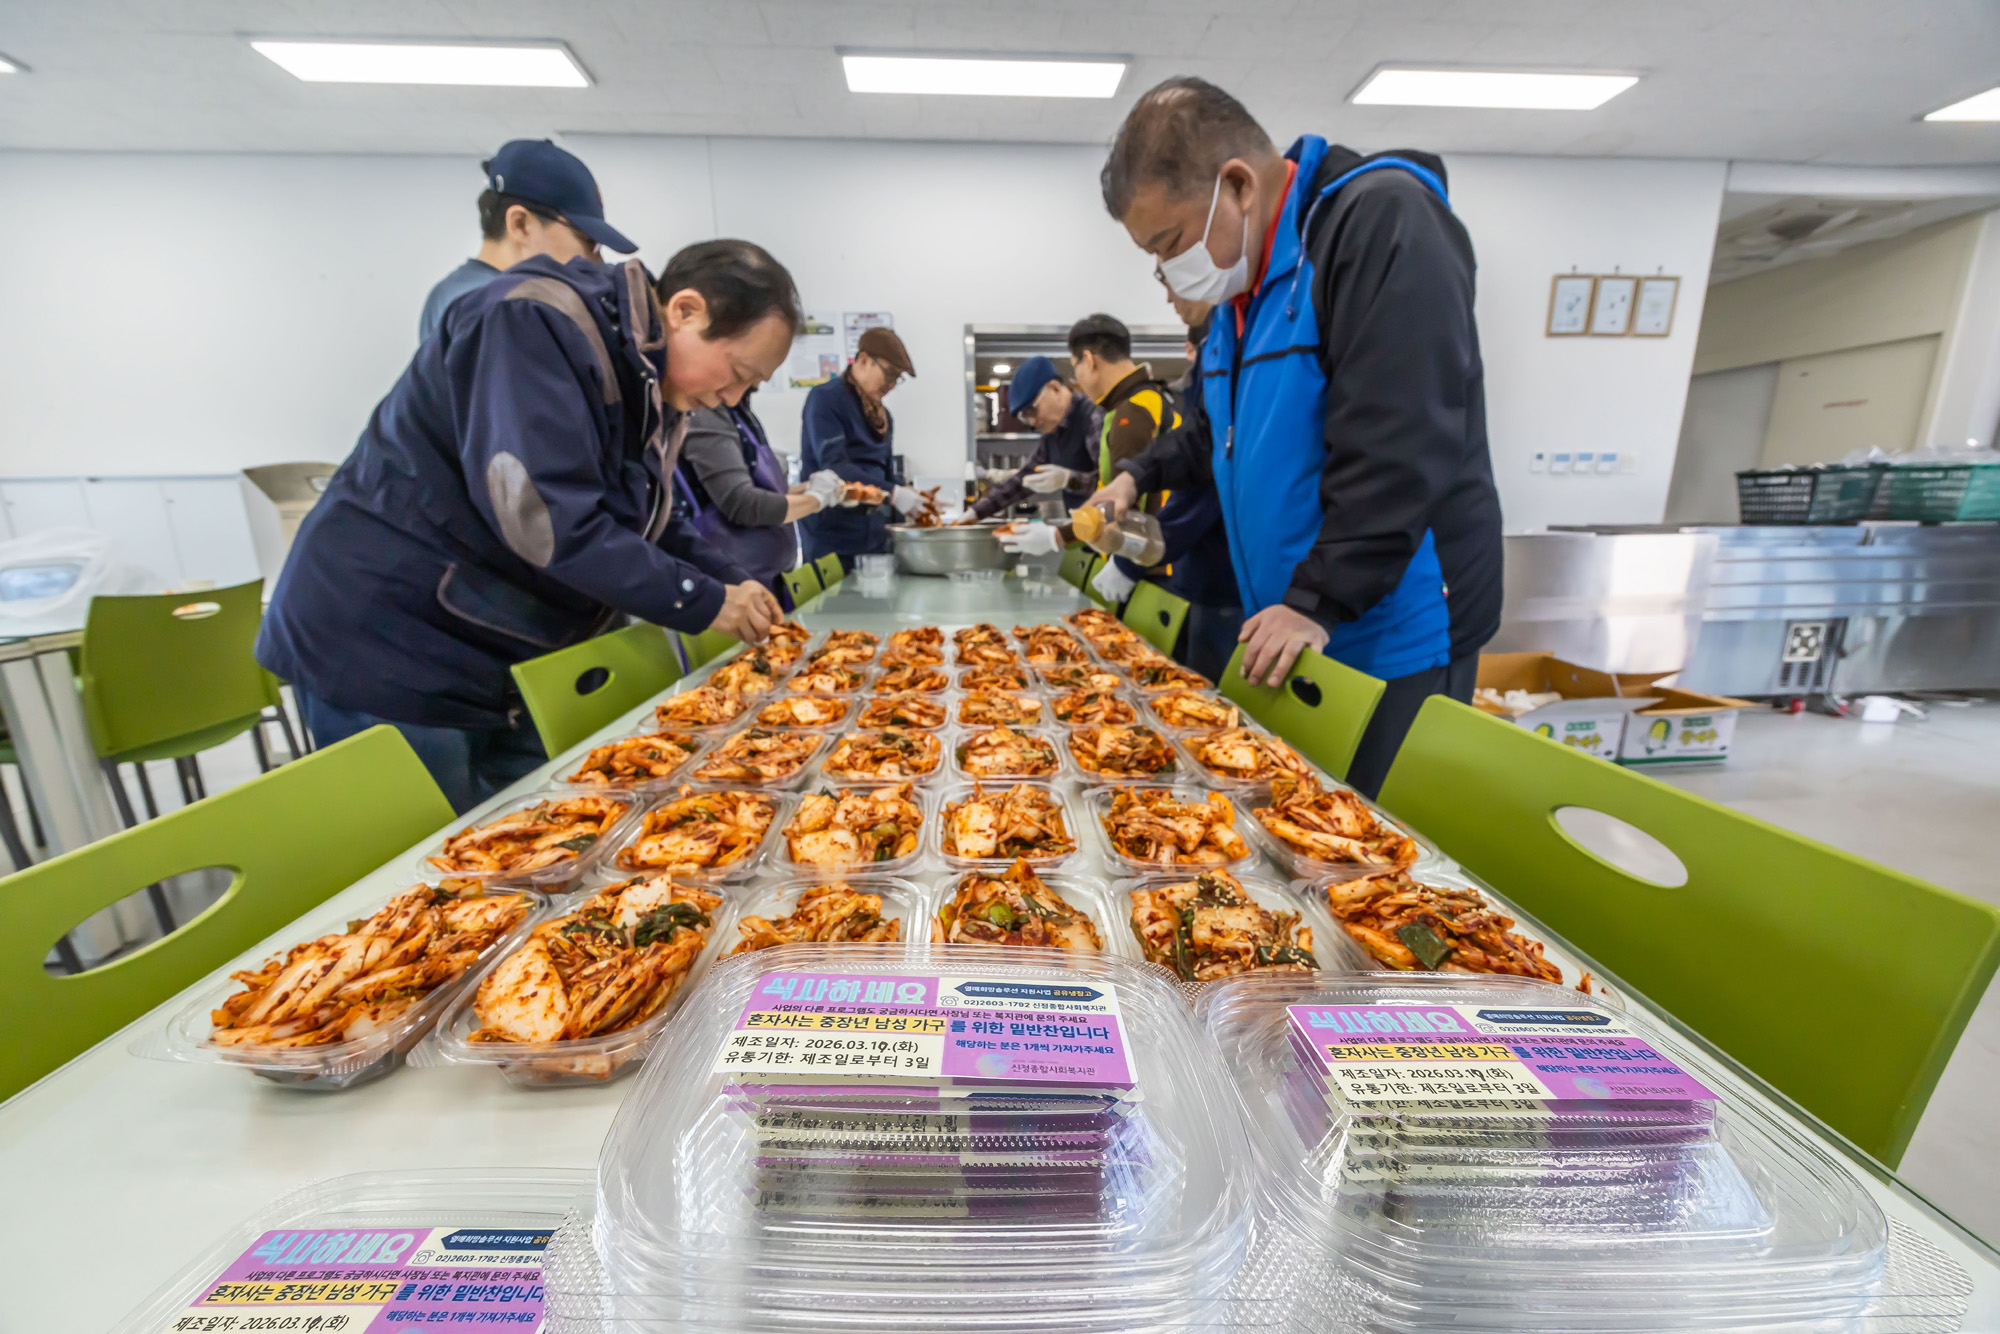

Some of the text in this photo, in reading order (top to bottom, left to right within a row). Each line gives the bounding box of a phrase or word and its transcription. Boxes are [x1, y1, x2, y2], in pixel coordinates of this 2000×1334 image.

[762, 977, 926, 1005] 식사하세요
[1020, 987, 1051, 996] 지원사업
[1053, 989, 1092, 998] 공유냉장고
[964, 999, 1106, 1012] 02)2603-1792 신정종합사회복지관
[772, 1004, 1088, 1024] 사업의 다른 프로그램도 궁금하시다면 사장님 또는 복지관에 문의 주세요
[747, 1013, 1110, 1040] 혼자사는 중장년 남성 가구 를 위한 밑반찬입니다
[1307, 1010, 1468, 1034] 식사하세요
[731, 1035, 799, 1049] 제조일자:
[955, 1039, 1116, 1055] 해당하는 분은 1개씩 가져가주세요
[1339, 1036, 1366, 1045] 사업의
[1367, 1036, 1387, 1045] 다른
[1388, 1036, 1433, 1045] 프로그램도
[1435, 1036, 1490, 1045] 궁금하시다면
[1520, 1037, 1538, 1045] 또는
[724, 1050, 930, 1070] 유통기한: 제조일로부터 3일
[1329, 1046, 1664, 1062] 혼자사는 중장년 남성 가구 를 위한 밑반찬입니다
[1011, 1064, 1096, 1076] 신정종합사회복지관
[1339, 1068, 1406, 1080] 제조일자:
[1350, 1083, 1541, 1096] 유통기한: 제조일로부터 3일
[503, 1235, 534, 1244] 지원사업
[251, 1232, 415, 1265] 식사하세요
[435, 1254, 500, 1264] 02)2603-1792
[245, 1270, 541, 1282] 사업의 다른 프로그램도 궁금하시다면 사장님 또는 복지관에 문의 주세요
[205, 1284, 275, 1302] 혼자사는
[274, 1284, 326, 1302] 중장년
[325, 1284, 366, 1301] 남성
[361, 1283, 399, 1301] 가구
[395, 1283, 419, 1301] 를
[417, 1283, 452, 1301] 위한
[172, 1315, 240, 1331] 제조일자:
[386, 1310, 537, 1324] 해당하는 분은 1개씩 가져가주세요
